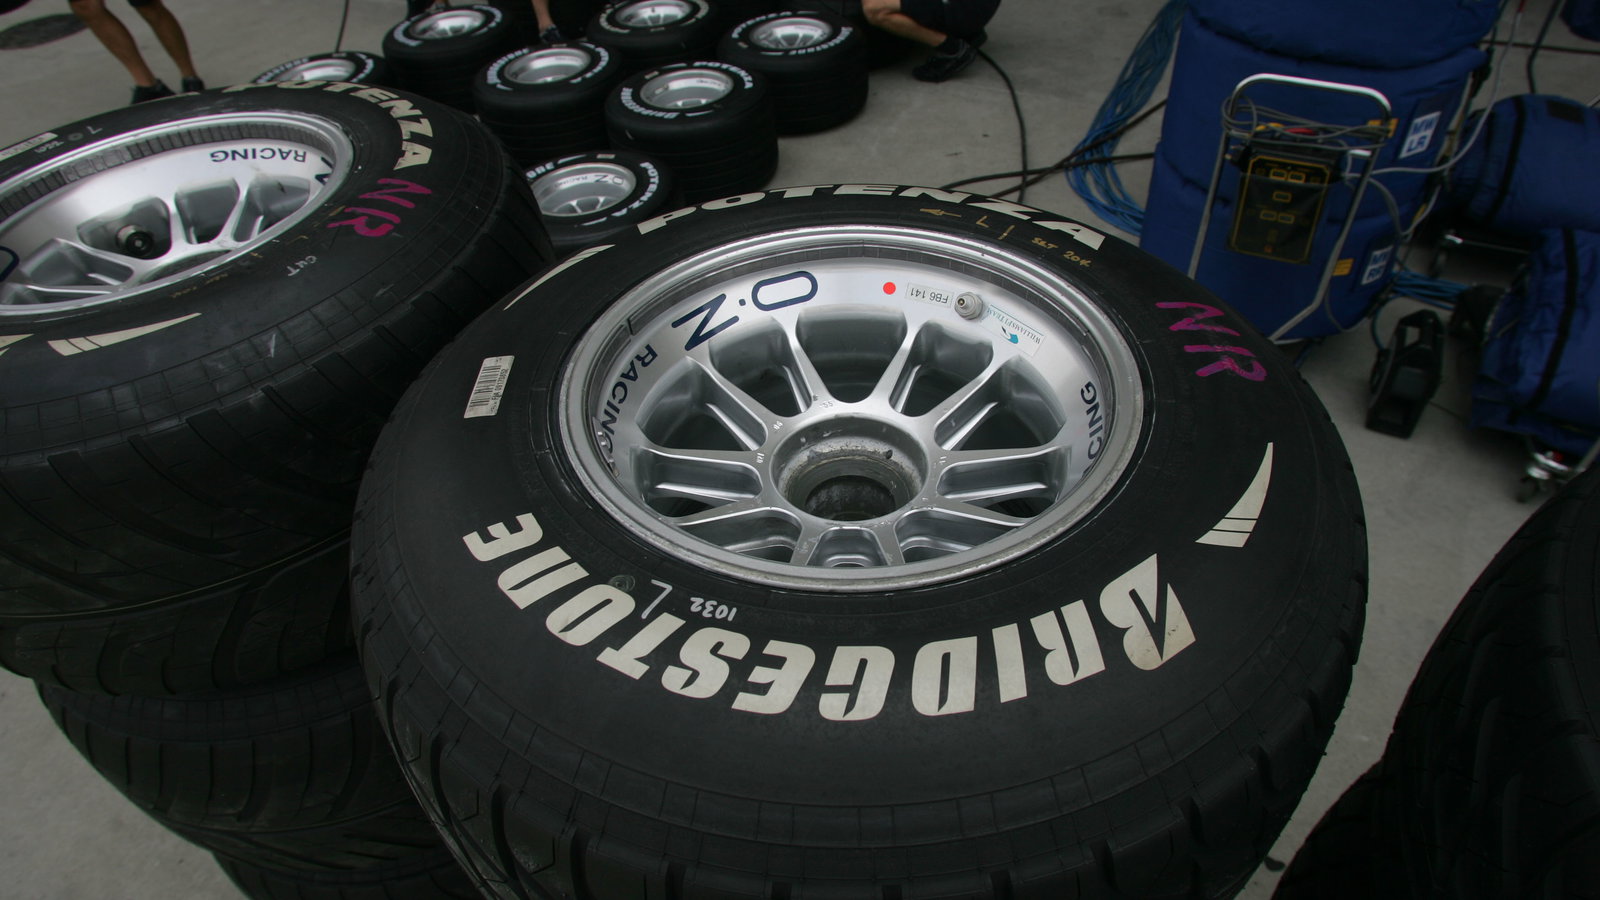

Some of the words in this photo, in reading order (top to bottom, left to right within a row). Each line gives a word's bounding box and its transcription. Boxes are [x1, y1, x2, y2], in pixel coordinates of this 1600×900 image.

[209, 147, 307, 163] RACING
[611, 161, 660, 217] POTENZA
[637, 183, 1106, 251] POTENZA
[909, 287, 926, 300] 141
[929, 291, 949, 305] FB6
[462, 512, 1197, 722] BRIDGESTONE
[690, 596, 738, 623] 1032
